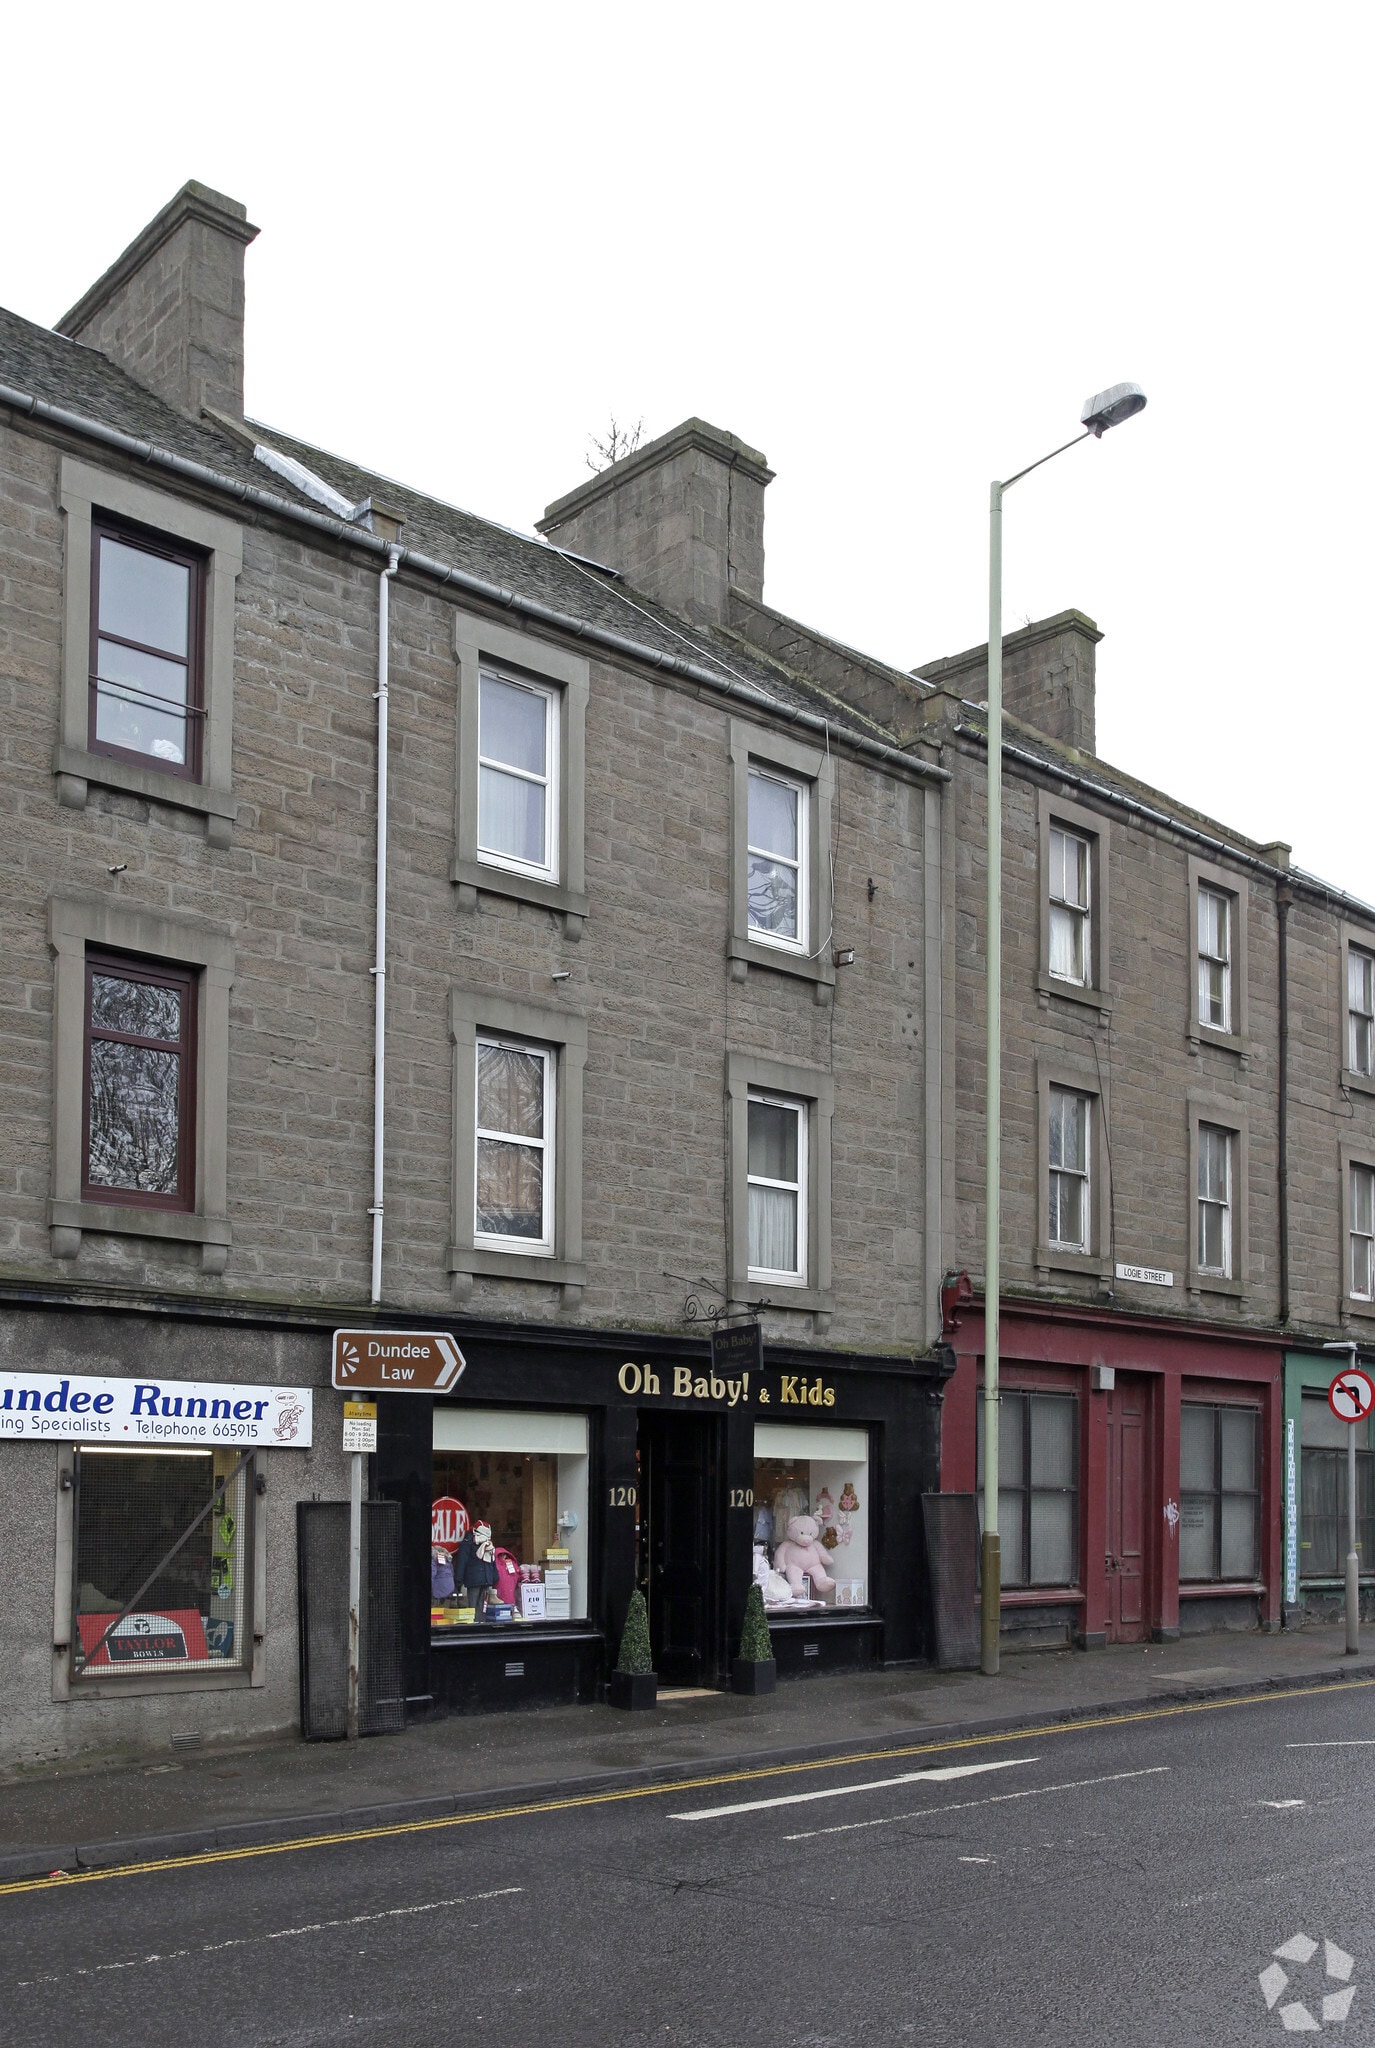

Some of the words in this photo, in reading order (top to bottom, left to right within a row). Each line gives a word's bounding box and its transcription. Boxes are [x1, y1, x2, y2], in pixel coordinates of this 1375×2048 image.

[1123, 1267, 1141, 1278] LOGIE
[1144, 1271, 1166, 1282] STREET
[367, 1341, 430, 1359] Dundee
[381, 1363, 415, 1380] Law
[618, 1362, 660, 1395] Oh
[672, 1366, 749, 1407] Baby!
[759, 1388, 770, 1403] &
[780, 1375, 835, 1407] Kids
[130, 1384, 270, 1421] Runner
[1, 1415, 24, 1433] ing
[31, 1416, 111, 1433] Specialists
[136, 1420, 207, 1438] Telephone
[212, 1423, 258, 1438] 665915
[609, 1487, 637, 1506] 120
[729, 1488, 754, 1507] 120
[114, 1637, 176, 1651] TAYLOR
[133, 1650, 164, 1658] BOWLS
